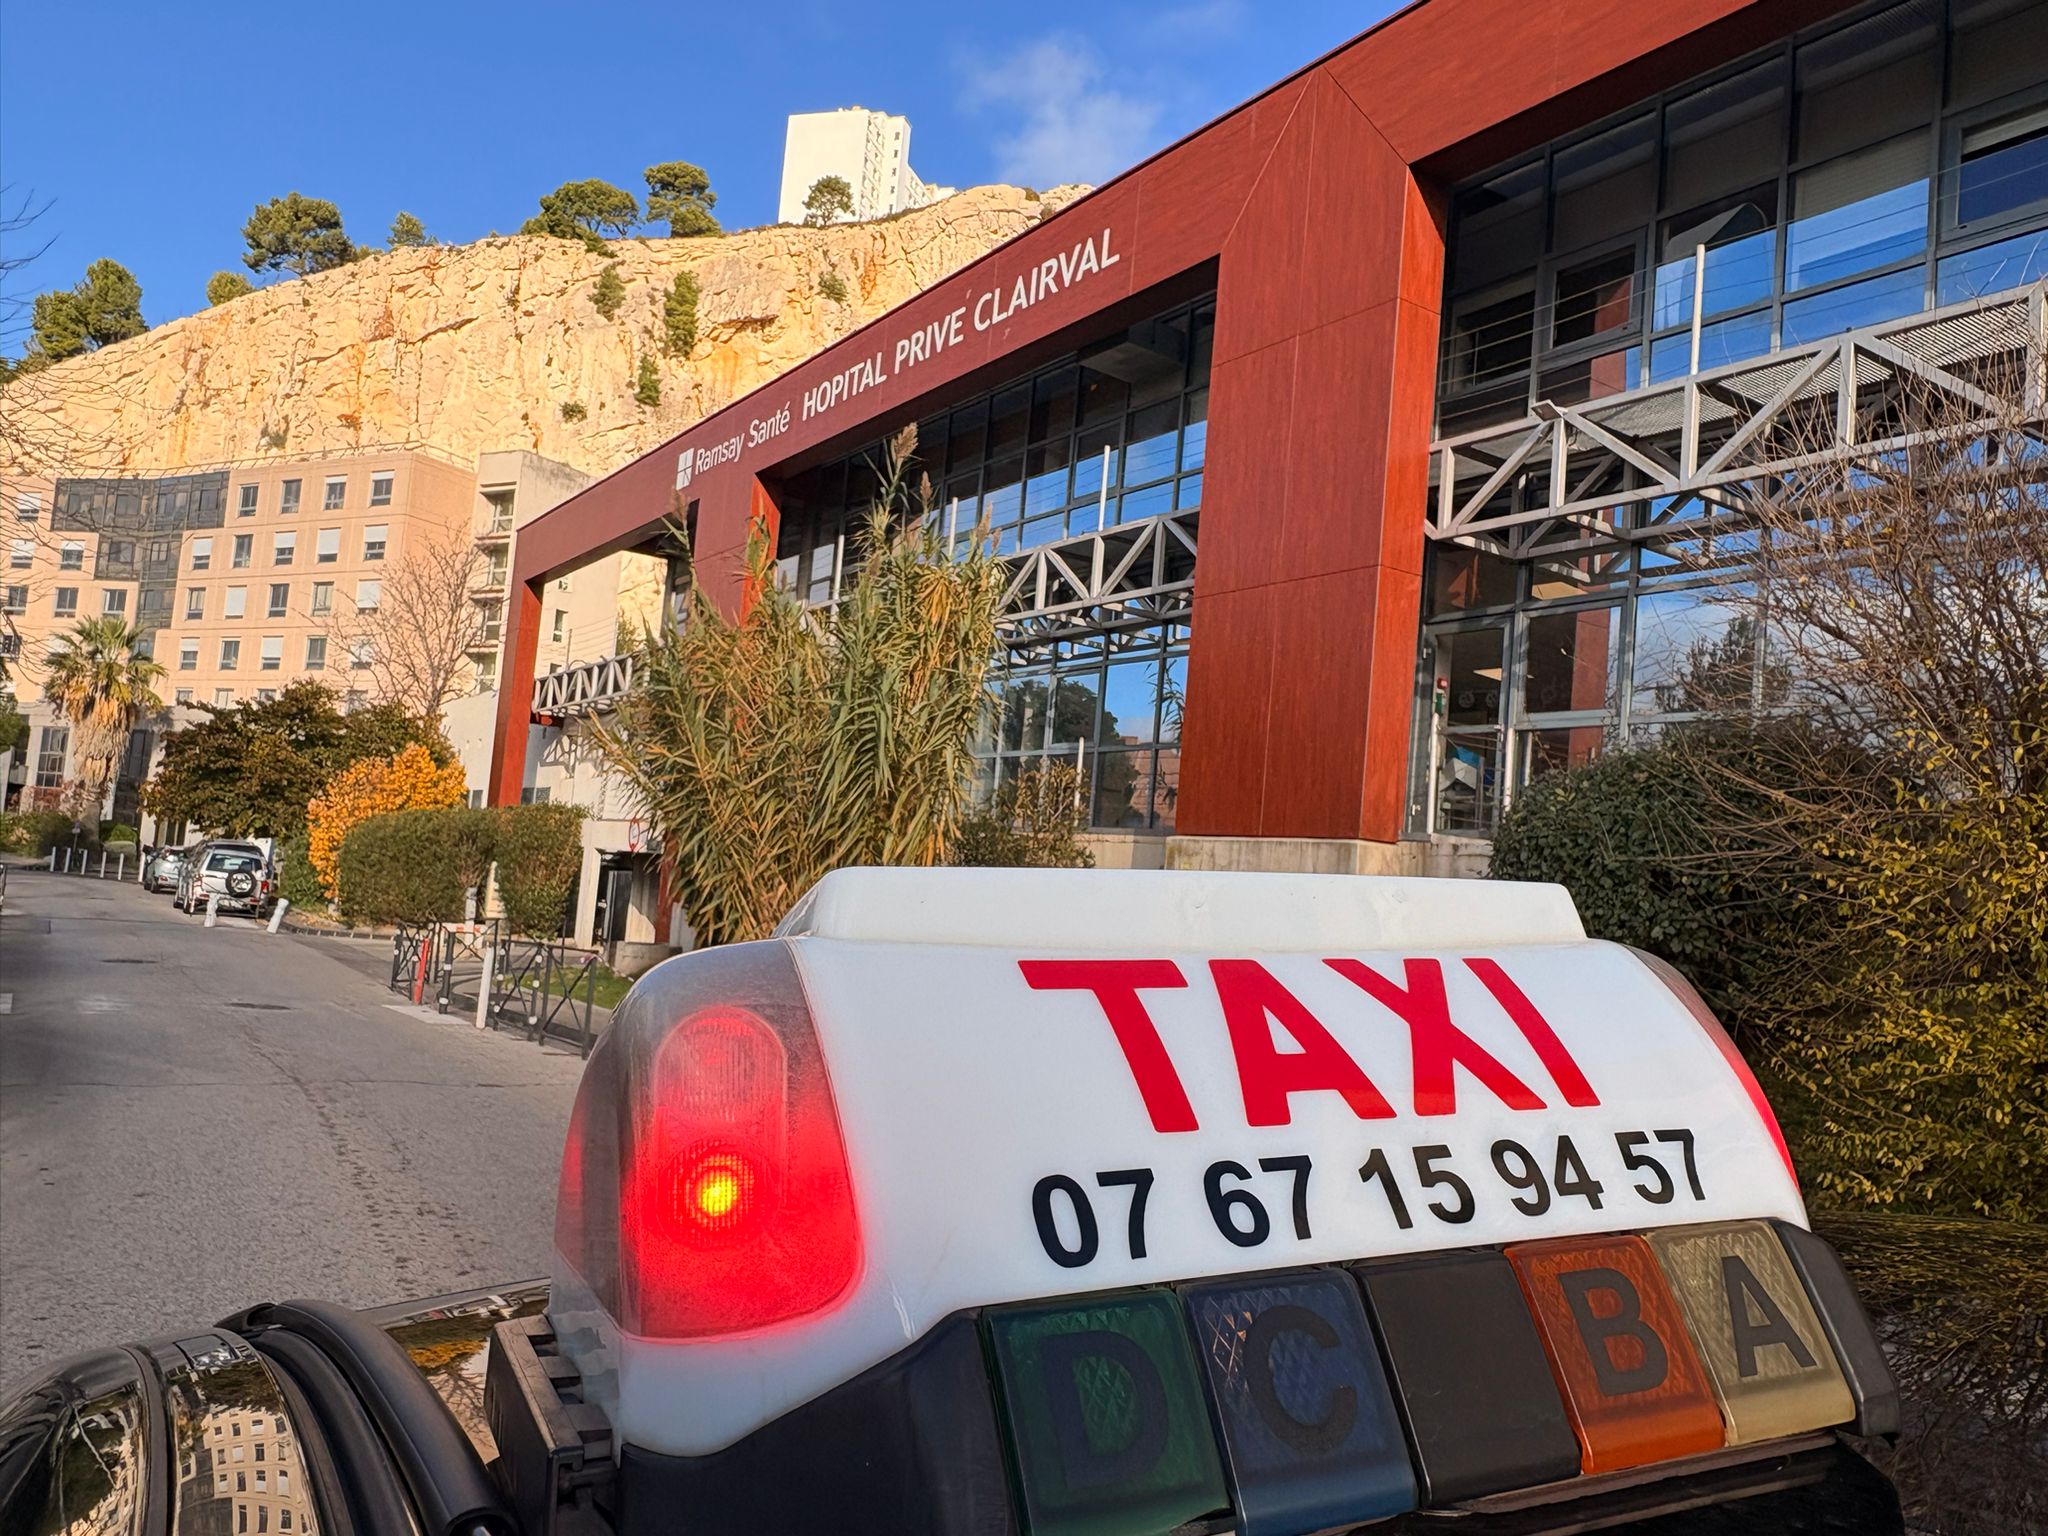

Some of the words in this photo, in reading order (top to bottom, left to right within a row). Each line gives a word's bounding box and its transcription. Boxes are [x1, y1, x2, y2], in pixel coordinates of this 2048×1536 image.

[695, 432, 745, 475] Ramsay
[748, 401, 791, 448] Santé
[802, 352, 887, 421] HOPITAL
[974, 228, 1120, 331] CLAIRVAL
[1017, 958, 1601, 1133] TAXI
[1031, 1167, 1154, 1268] 07
[1203, 1154, 1311, 1247] 67
[1359, 1144, 1476, 1230] 15
[1490, 1135, 1604, 1216] 94
[1614, 1128, 1706, 1204] 57
[1040, 1330, 1169, 1489] D
[1243, 1305, 1357, 1454] C
[1558, 1267, 1669, 1397] B
[1721, 1255, 1818, 1378] A
